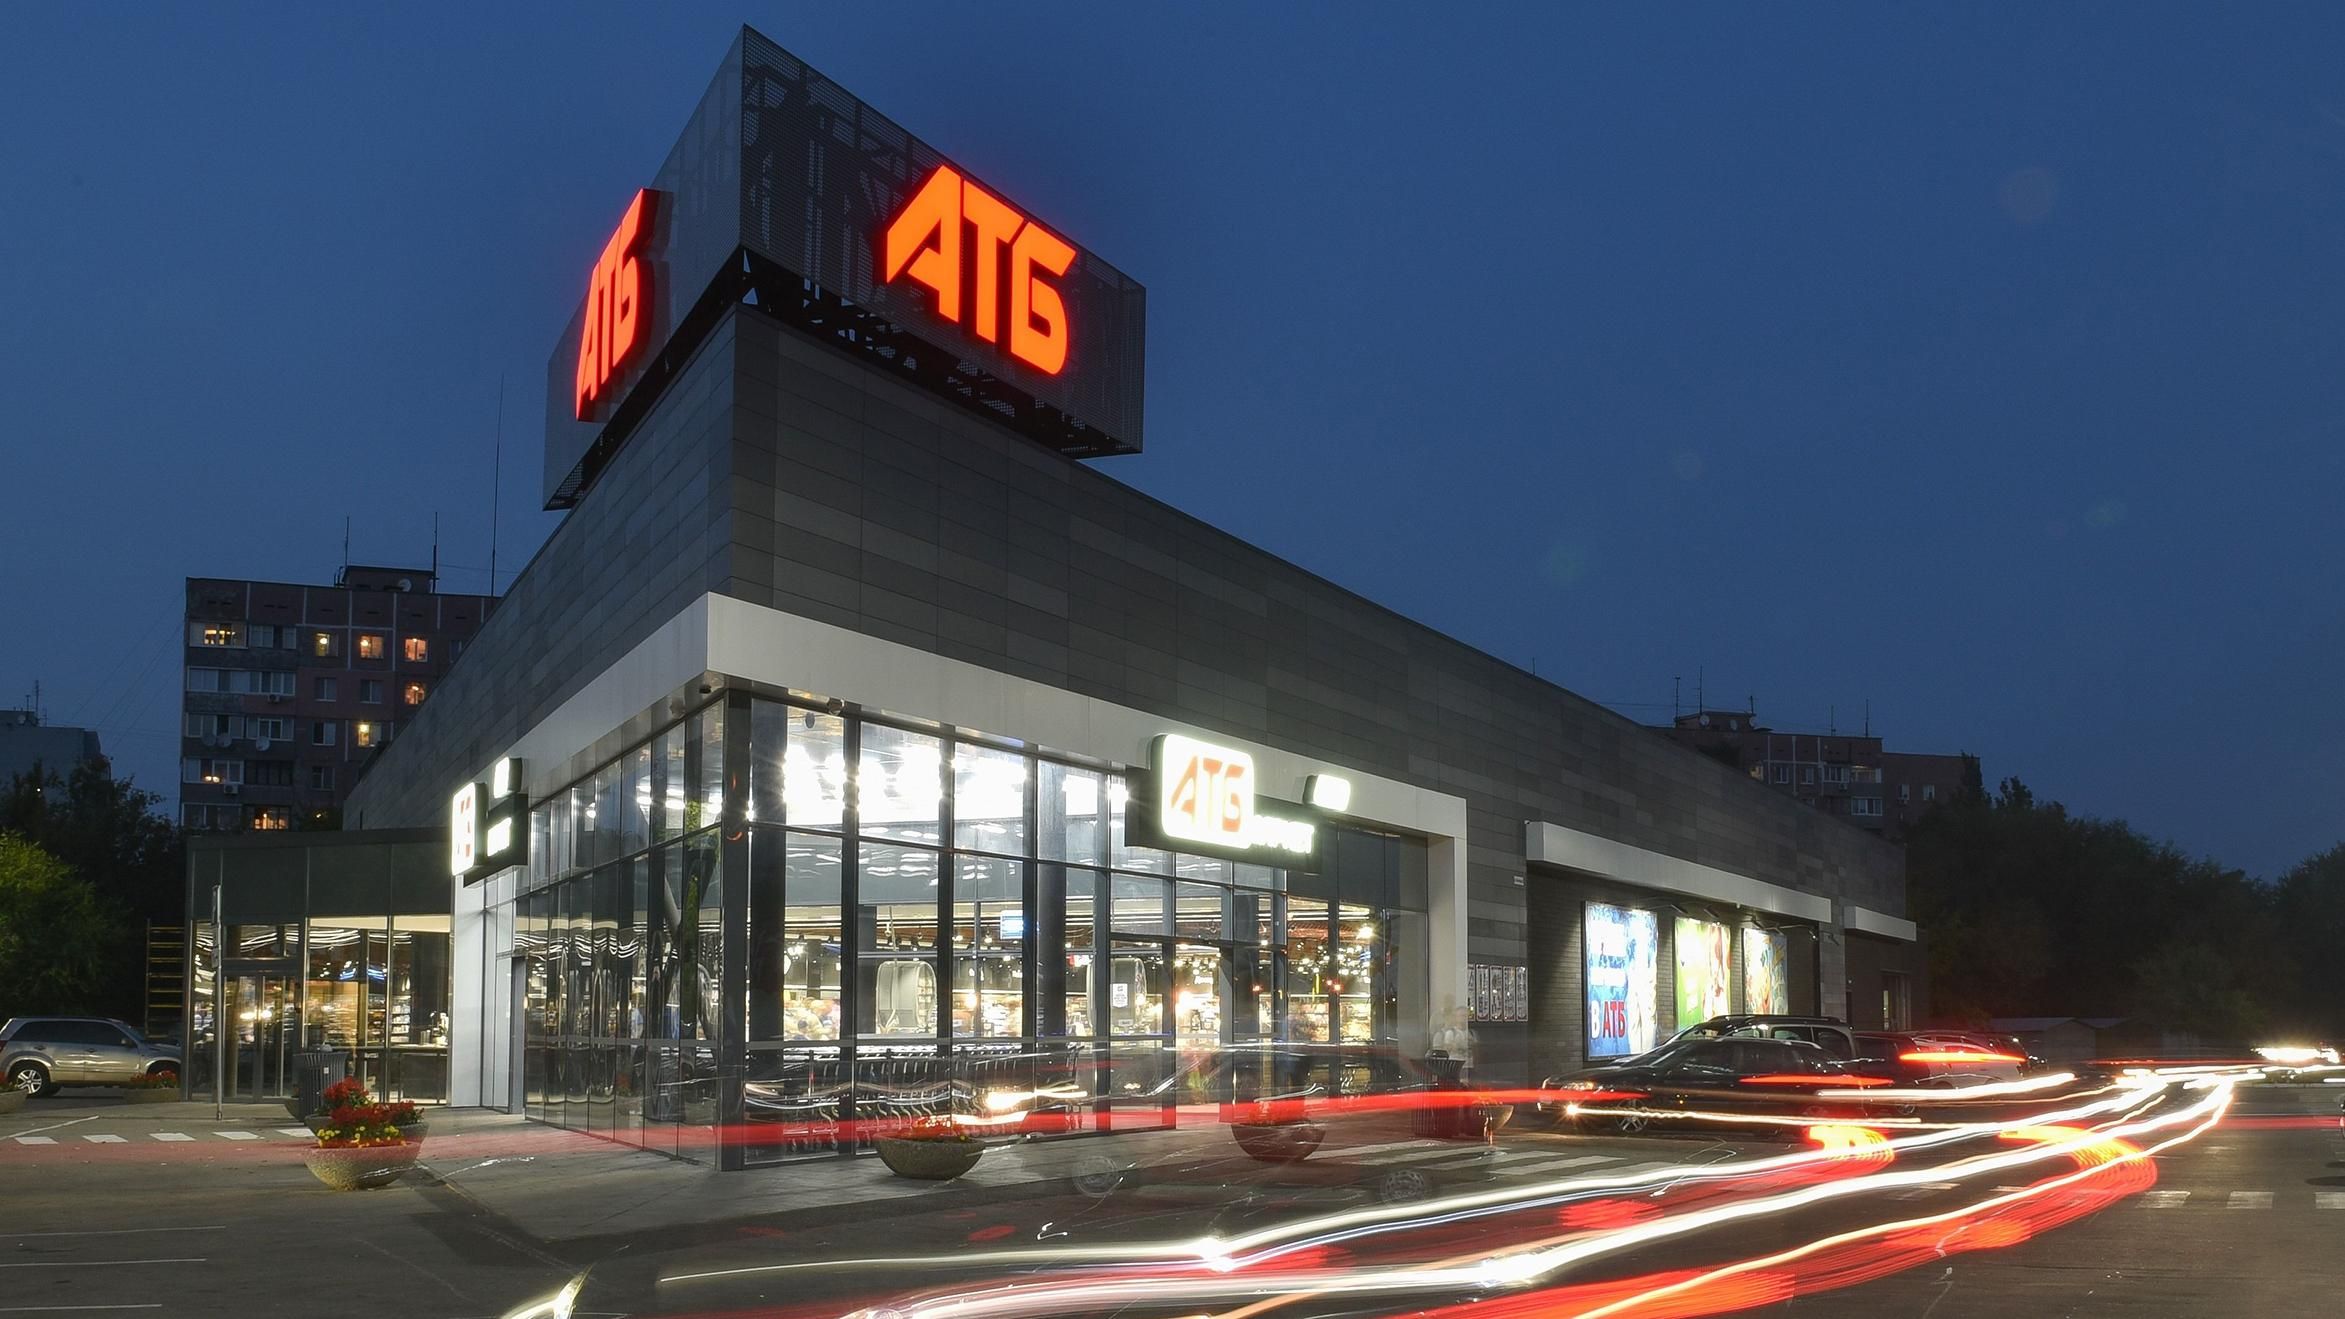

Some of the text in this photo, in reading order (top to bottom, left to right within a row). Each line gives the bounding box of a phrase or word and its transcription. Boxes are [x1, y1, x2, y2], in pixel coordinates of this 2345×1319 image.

[576, 187, 644, 422] АТБ
[886, 164, 1077, 376] АТБ
[1170, 755, 1245, 832] АТБ
[1603, 1000, 1626, 1039] АТБ
